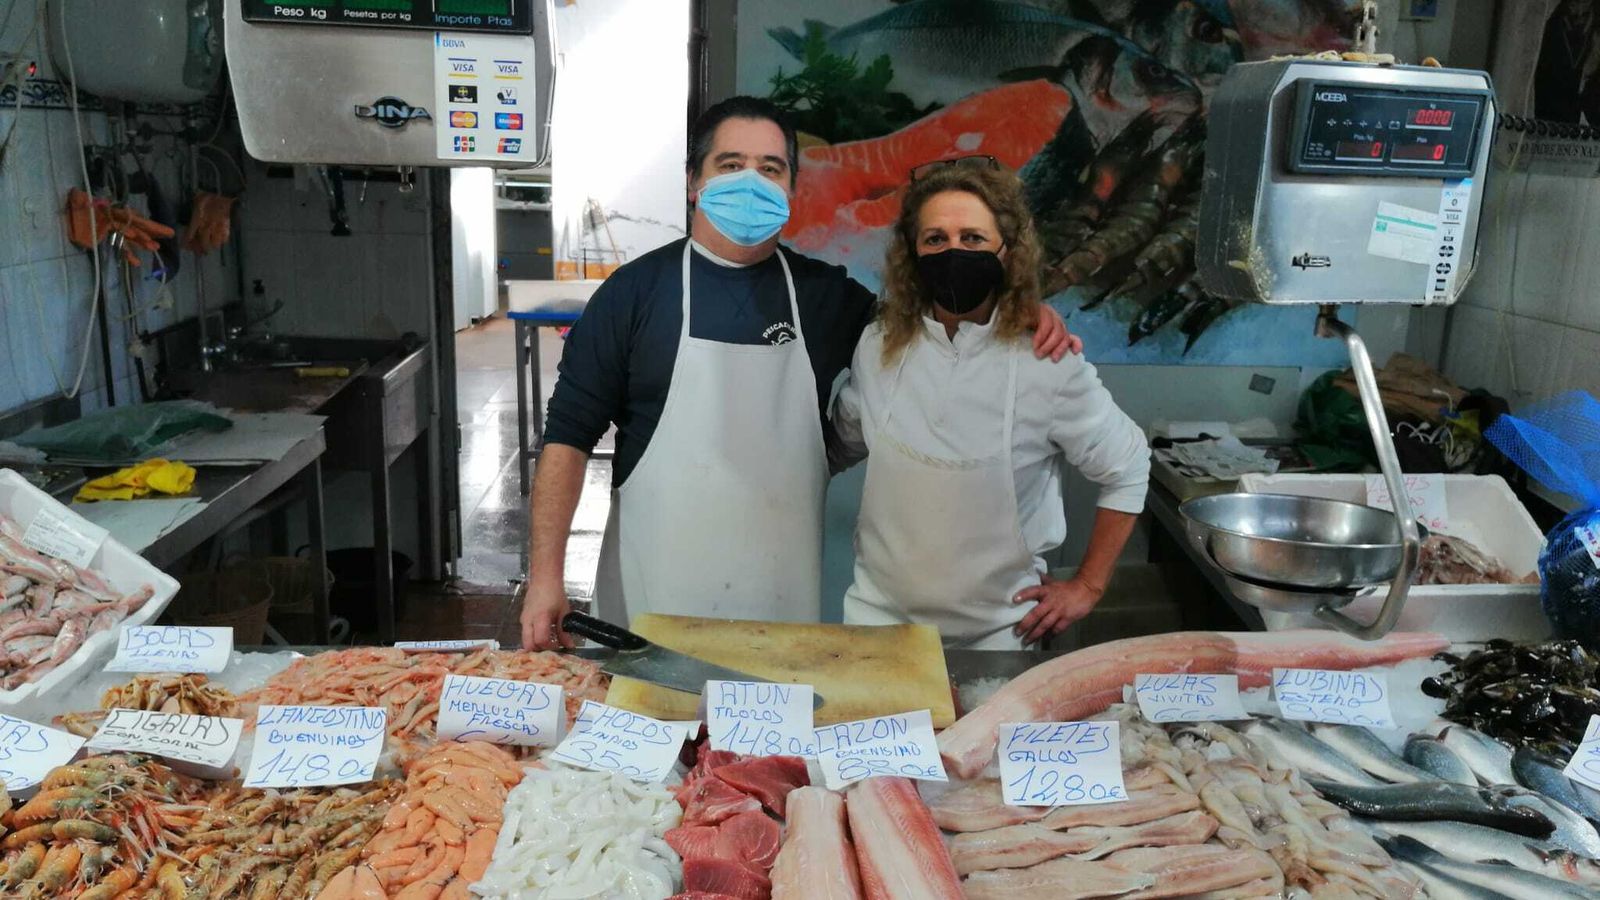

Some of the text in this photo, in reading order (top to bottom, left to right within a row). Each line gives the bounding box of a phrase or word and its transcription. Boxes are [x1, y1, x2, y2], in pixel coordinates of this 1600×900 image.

[274, 5, 327, 20] Peso kg
[344, 9, 412, 22] Pesetas por kg
[435, 13, 513, 27] Importe Ptas
[443, 39, 466, 49] BBVA
[453, 63, 475, 73] VISA
[498, 64, 519, 74] VISA
[354, 103, 433, 122] DINA
[1370, 142, 1382, 157] 0
[1433, 144, 1445, 160] 0
[121, 625, 215, 650] BOCAS
[720, 681, 791, 706] ATUN
[106, 709, 230, 746] CIGALAS
[577, 701, 673, 745] CHOCOS
[814, 717, 908, 754] CAZON
[1006, 721, 1110, 755] FILETES
[1008, 749, 1078, 764] GALLOS
